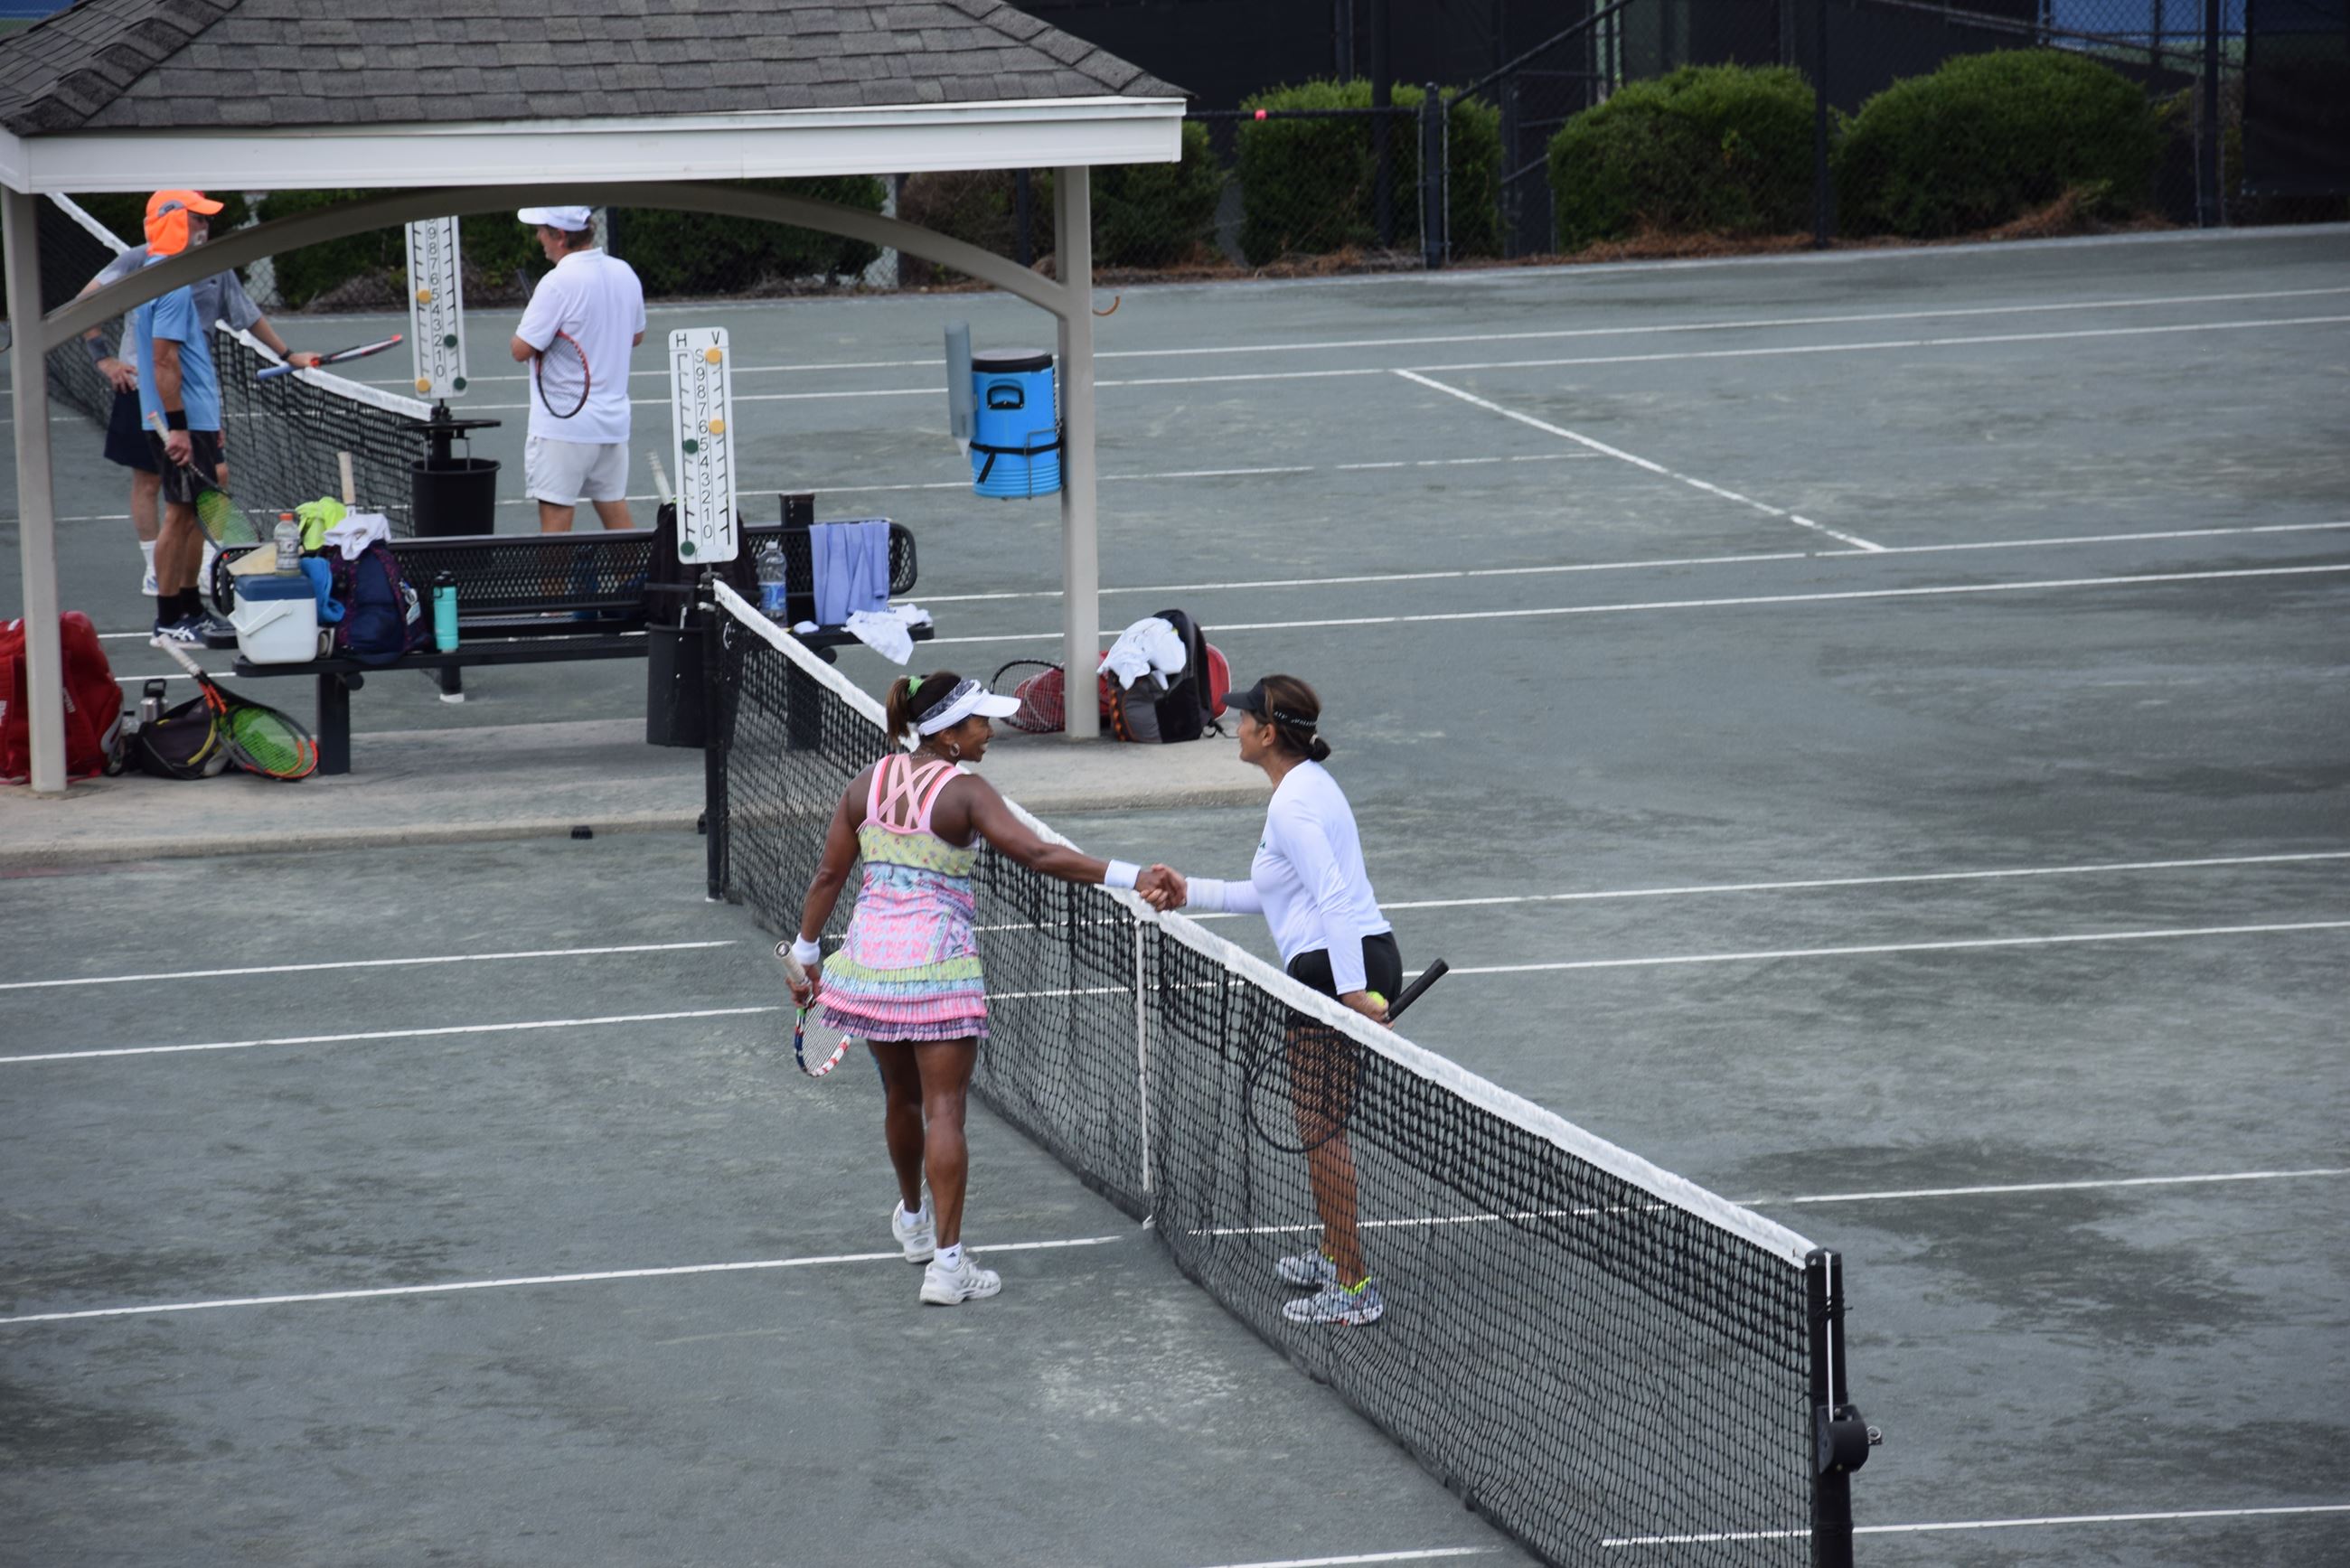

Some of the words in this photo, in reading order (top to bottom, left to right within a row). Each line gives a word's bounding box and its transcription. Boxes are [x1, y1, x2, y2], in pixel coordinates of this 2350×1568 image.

[428, 227, 437, 239] 9
[428, 242, 437, 255] 8
[429, 257, 437, 269] 7
[430, 273, 439, 286] 6
[431, 288, 440, 301] 5
[432, 304, 440, 315] 4
[434, 319, 442, 332] 3
[434, 334, 442, 347] 2
[676, 333, 687, 347] H
[711, 331, 720, 345] V
[695, 348, 705, 363] S
[436, 364, 445, 378] 0
[696, 367, 705, 380] 9
[697, 384, 706, 399] 8
[698, 402, 706, 417] 7
[699, 419, 708, 434] 6
[700, 437, 709, 452] 5
[700, 455, 710, 468] 4
[701, 472, 710, 486] 3
[701, 490, 710, 504] 2
[703, 524, 712, 539] 0
